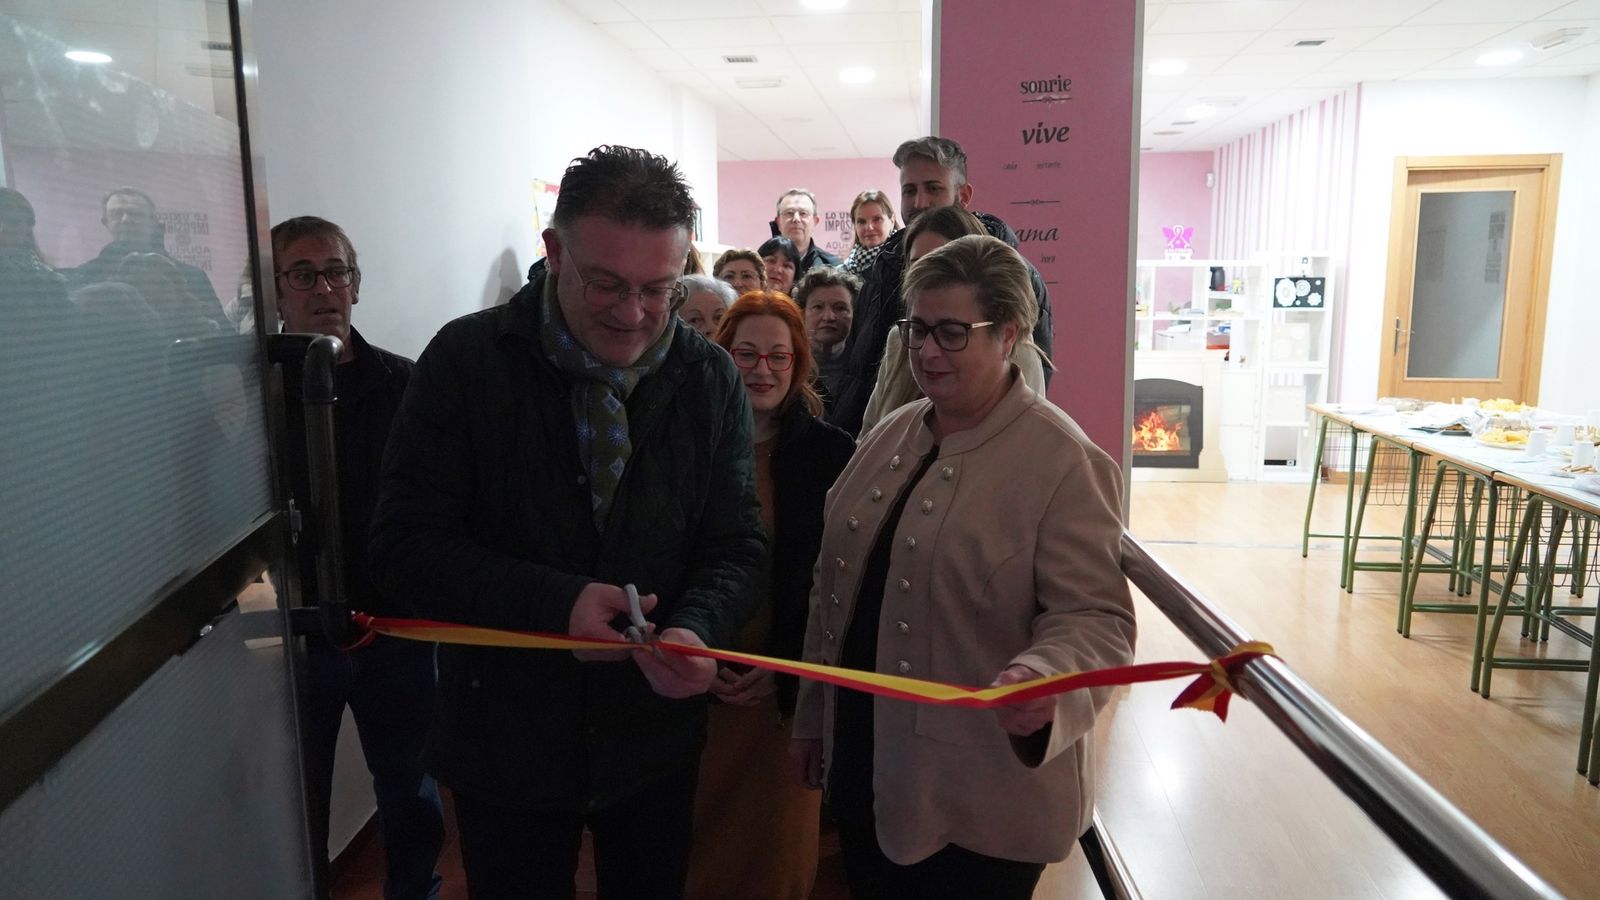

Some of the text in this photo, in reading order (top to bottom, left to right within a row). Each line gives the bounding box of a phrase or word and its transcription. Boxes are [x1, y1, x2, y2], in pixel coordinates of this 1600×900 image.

[1020, 74, 1072, 95] sonrie
[1022, 122, 1070, 145] vive
[825, 212, 836, 220] LO
[1014, 227, 1060, 243] ama
